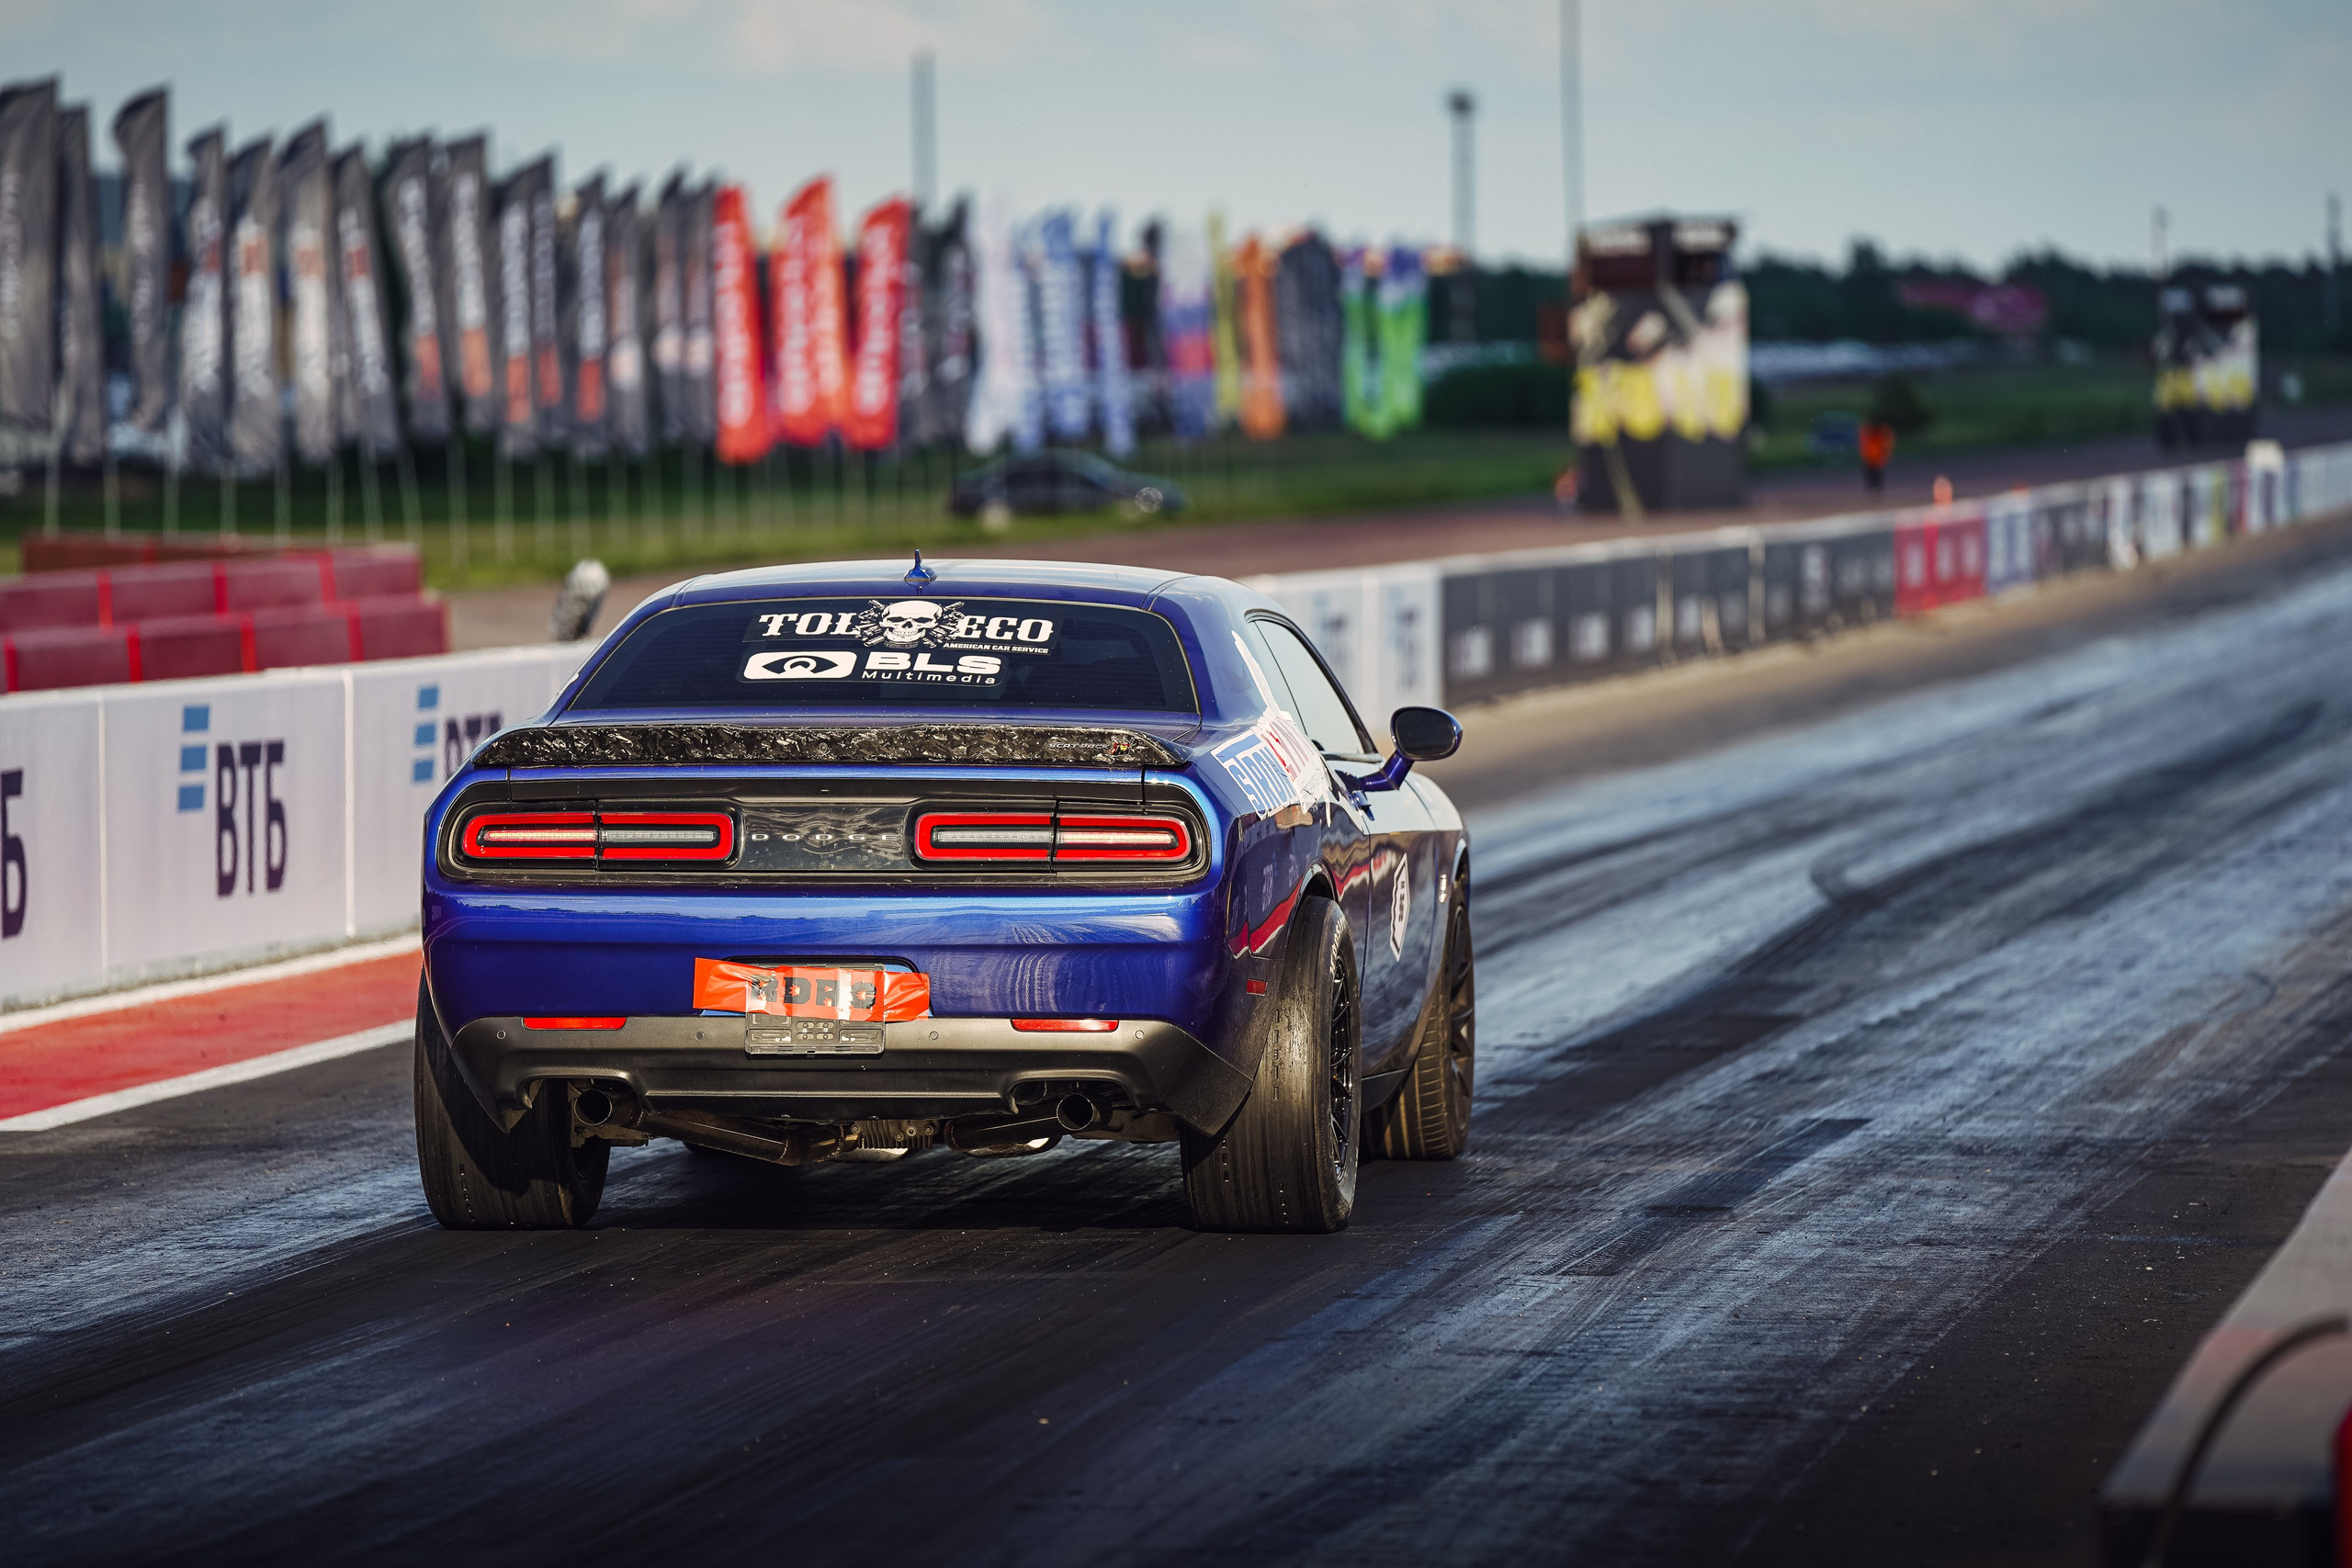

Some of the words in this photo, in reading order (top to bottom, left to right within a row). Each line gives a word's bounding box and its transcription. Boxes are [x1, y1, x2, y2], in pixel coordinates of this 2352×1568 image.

[943, 642, 991, 650] AMERICAN
[1012, 646, 1049, 654] SERVICE
[865, 651, 1001, 675] BLS
[862, 671, 996, 684] Multimedia
[215, 740, 288, 898] ВТБ
[752, 833, 898, 841] DODGE
